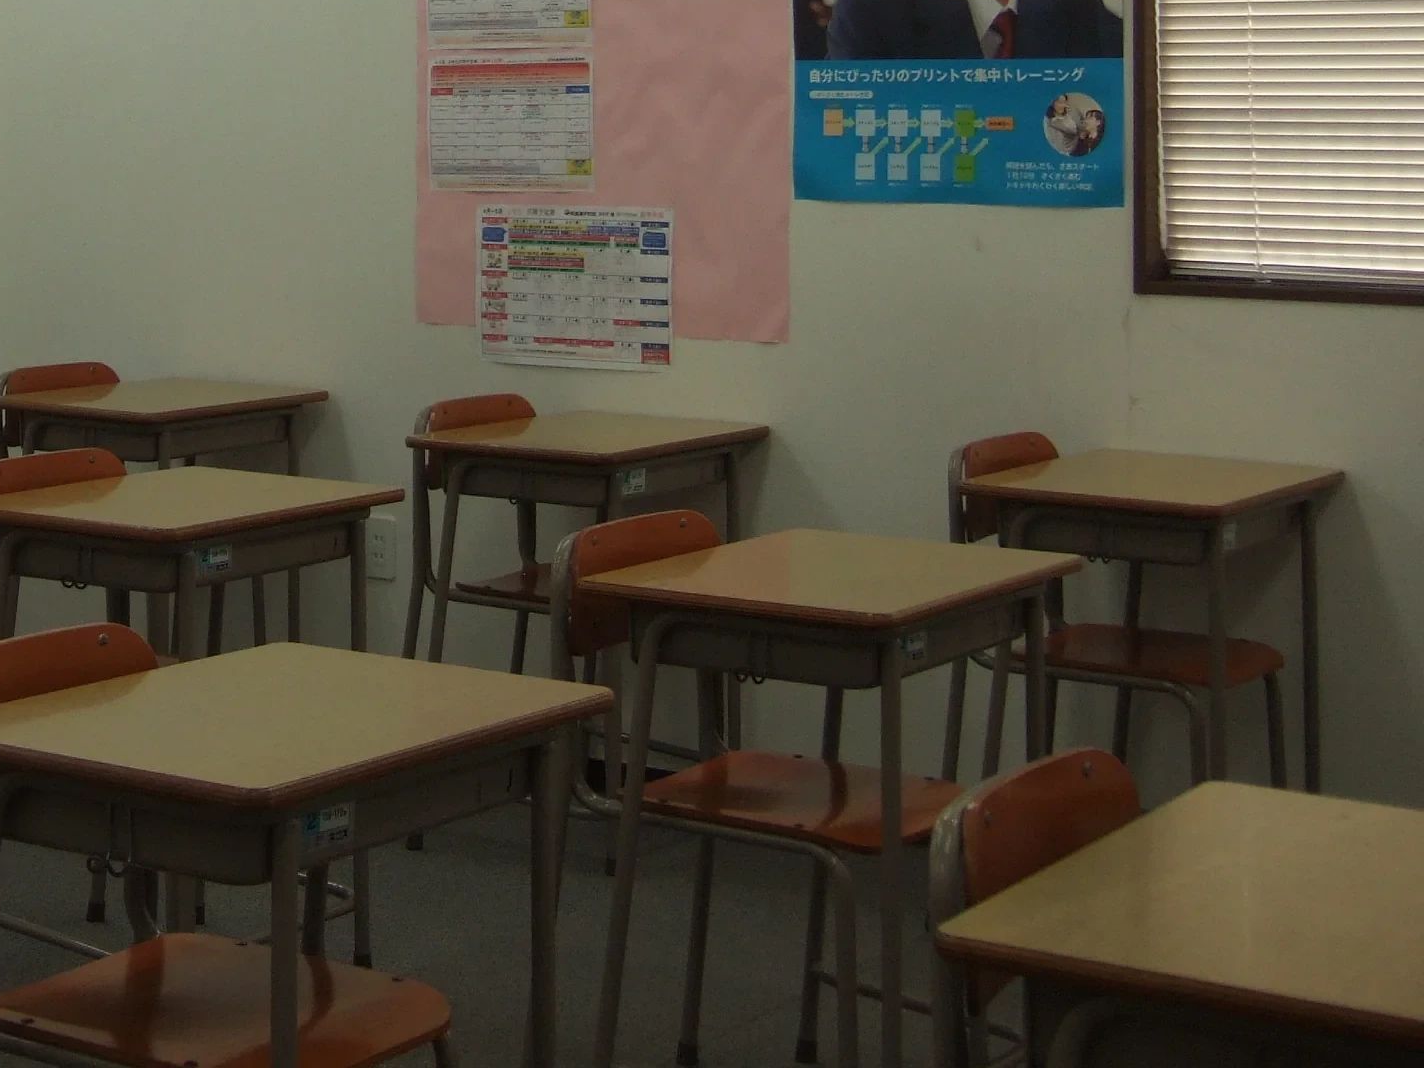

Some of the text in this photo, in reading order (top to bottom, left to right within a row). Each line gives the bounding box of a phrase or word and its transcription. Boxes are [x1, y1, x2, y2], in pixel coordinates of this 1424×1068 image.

[808, 67, 1085, 84] 自分にぴったりのプリントで集中トレーニング
